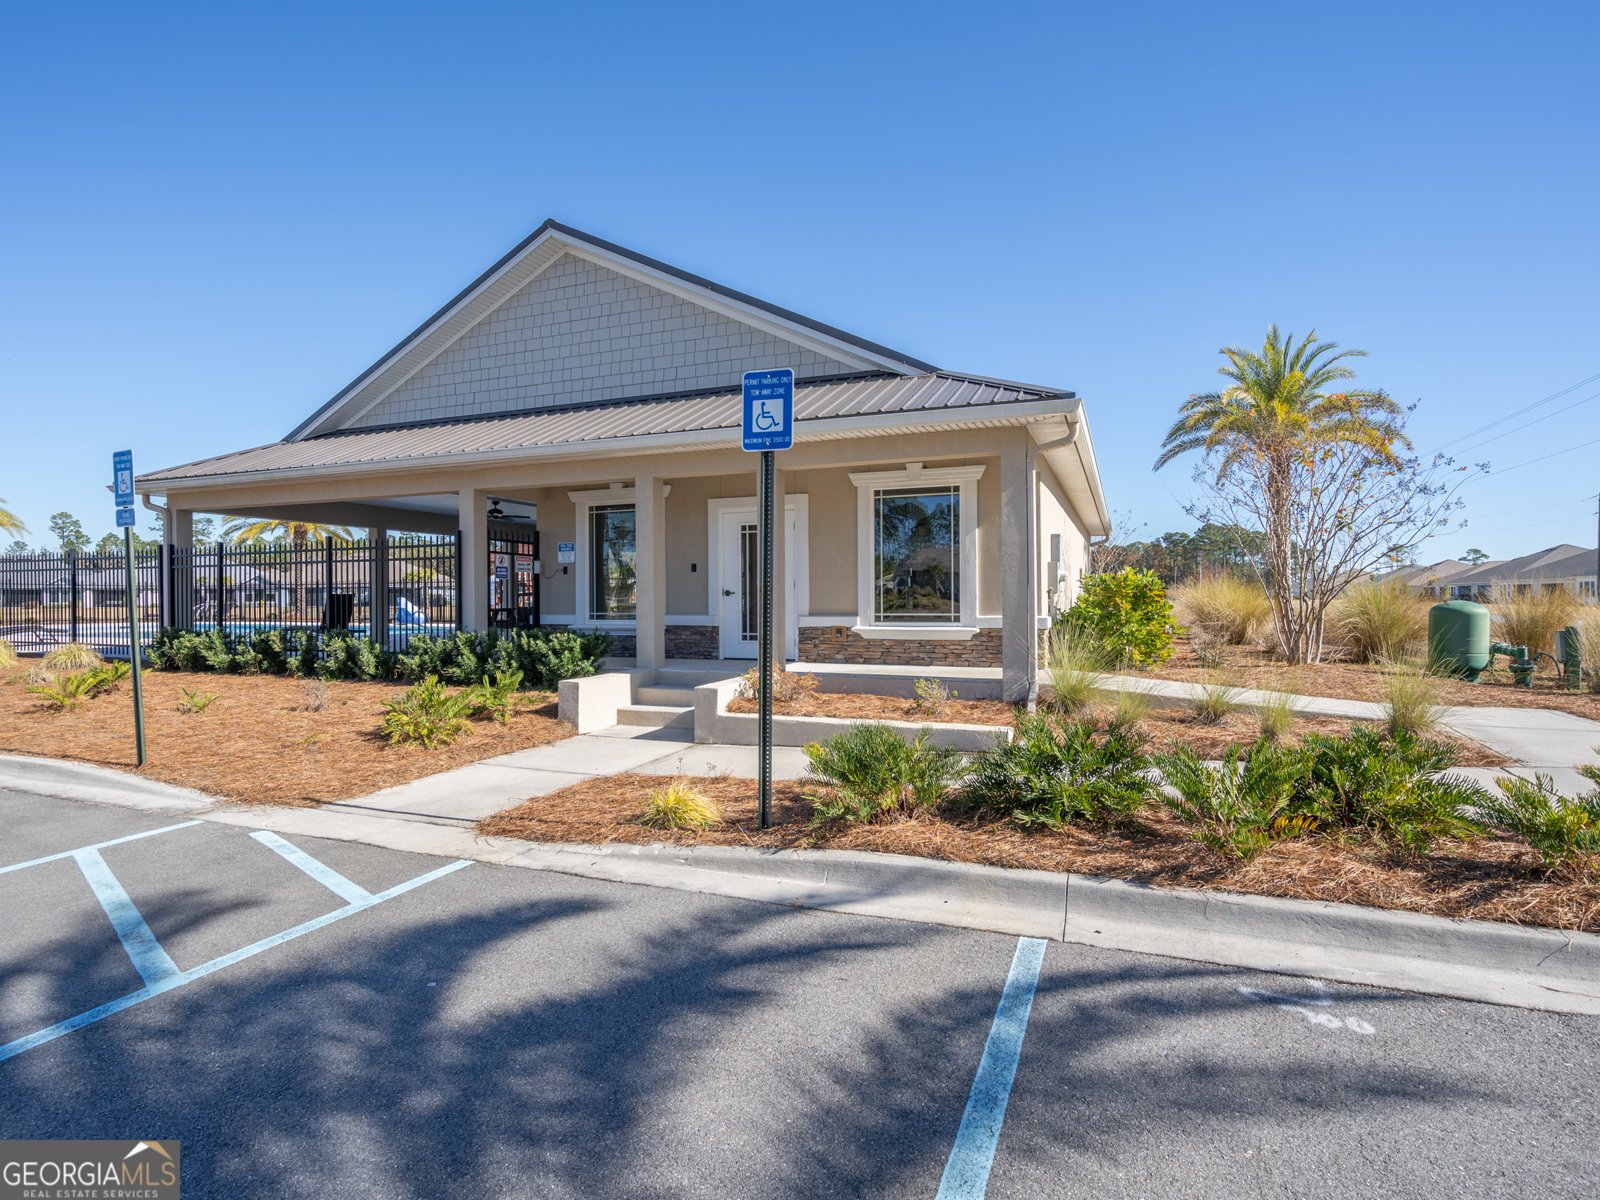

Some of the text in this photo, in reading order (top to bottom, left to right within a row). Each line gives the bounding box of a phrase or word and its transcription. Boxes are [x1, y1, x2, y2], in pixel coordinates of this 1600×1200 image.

[760, 377, 780, 385] PARKING
[780, 376, 792, 384] ONLY
[750, 387, 785, 396] TOW-AWAY ZONE
